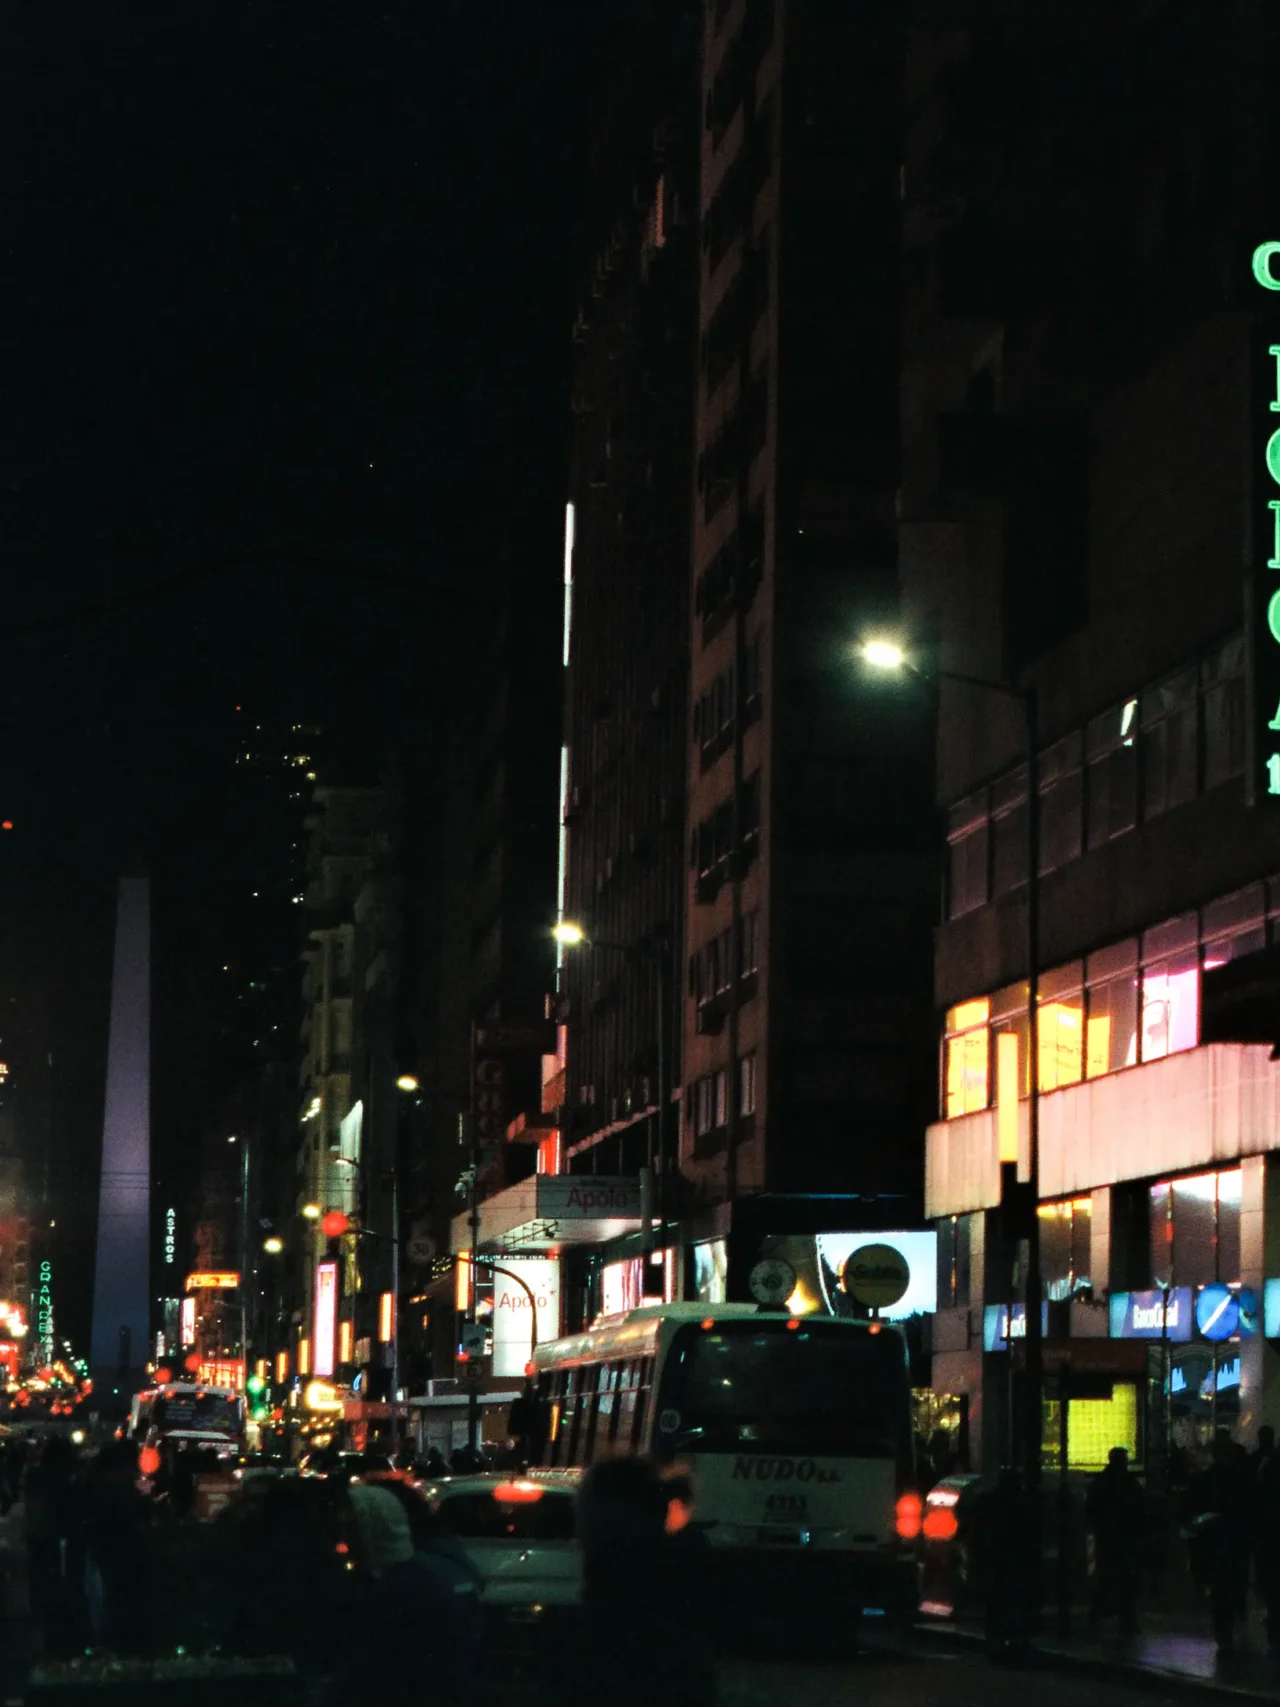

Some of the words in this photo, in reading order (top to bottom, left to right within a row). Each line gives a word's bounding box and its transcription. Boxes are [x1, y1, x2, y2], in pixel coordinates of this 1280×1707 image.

[565, 1187, 629, 1213] Apolo
[166, 1208, 176, 1263] ASTROS
[732, 1457, 816, 1481] NUDO
